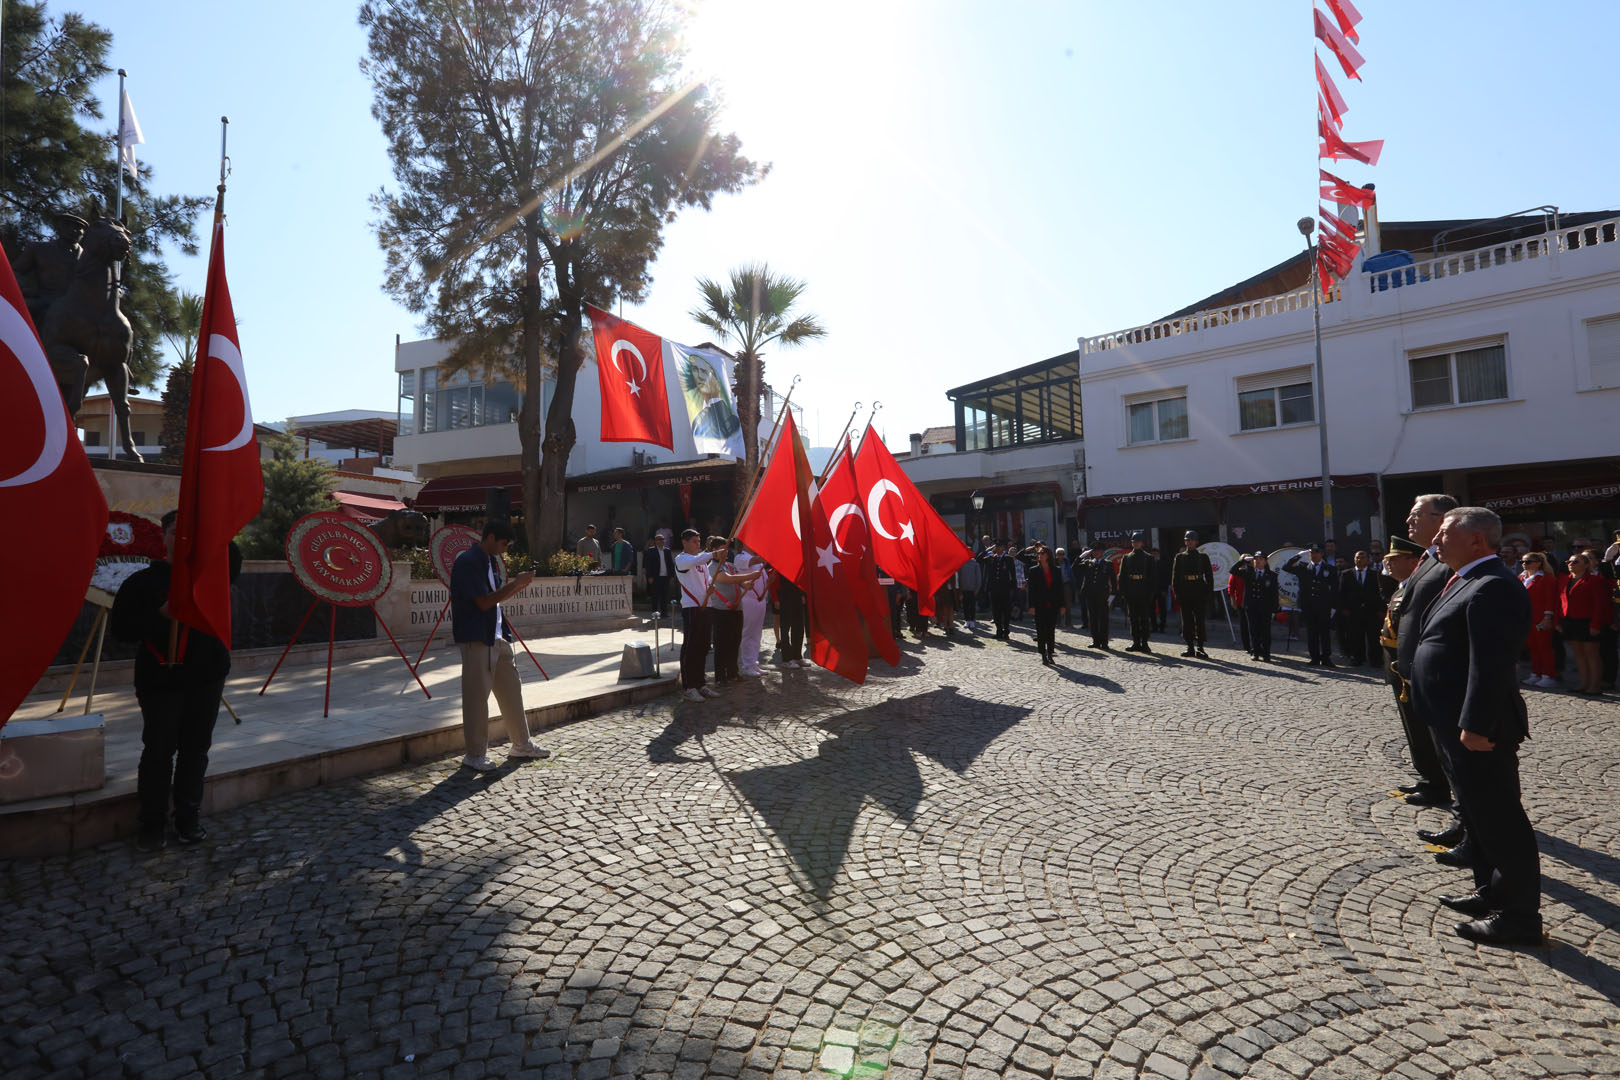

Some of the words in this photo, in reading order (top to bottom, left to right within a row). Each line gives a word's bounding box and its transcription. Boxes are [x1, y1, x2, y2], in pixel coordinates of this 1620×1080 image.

[686, 474, 711, 483] CAFE
[1113, 491, 1182, 504] VETERİNER
[411, 590, 448, 605] CUMHU
[411, 609, 453, 625] DAYANA
